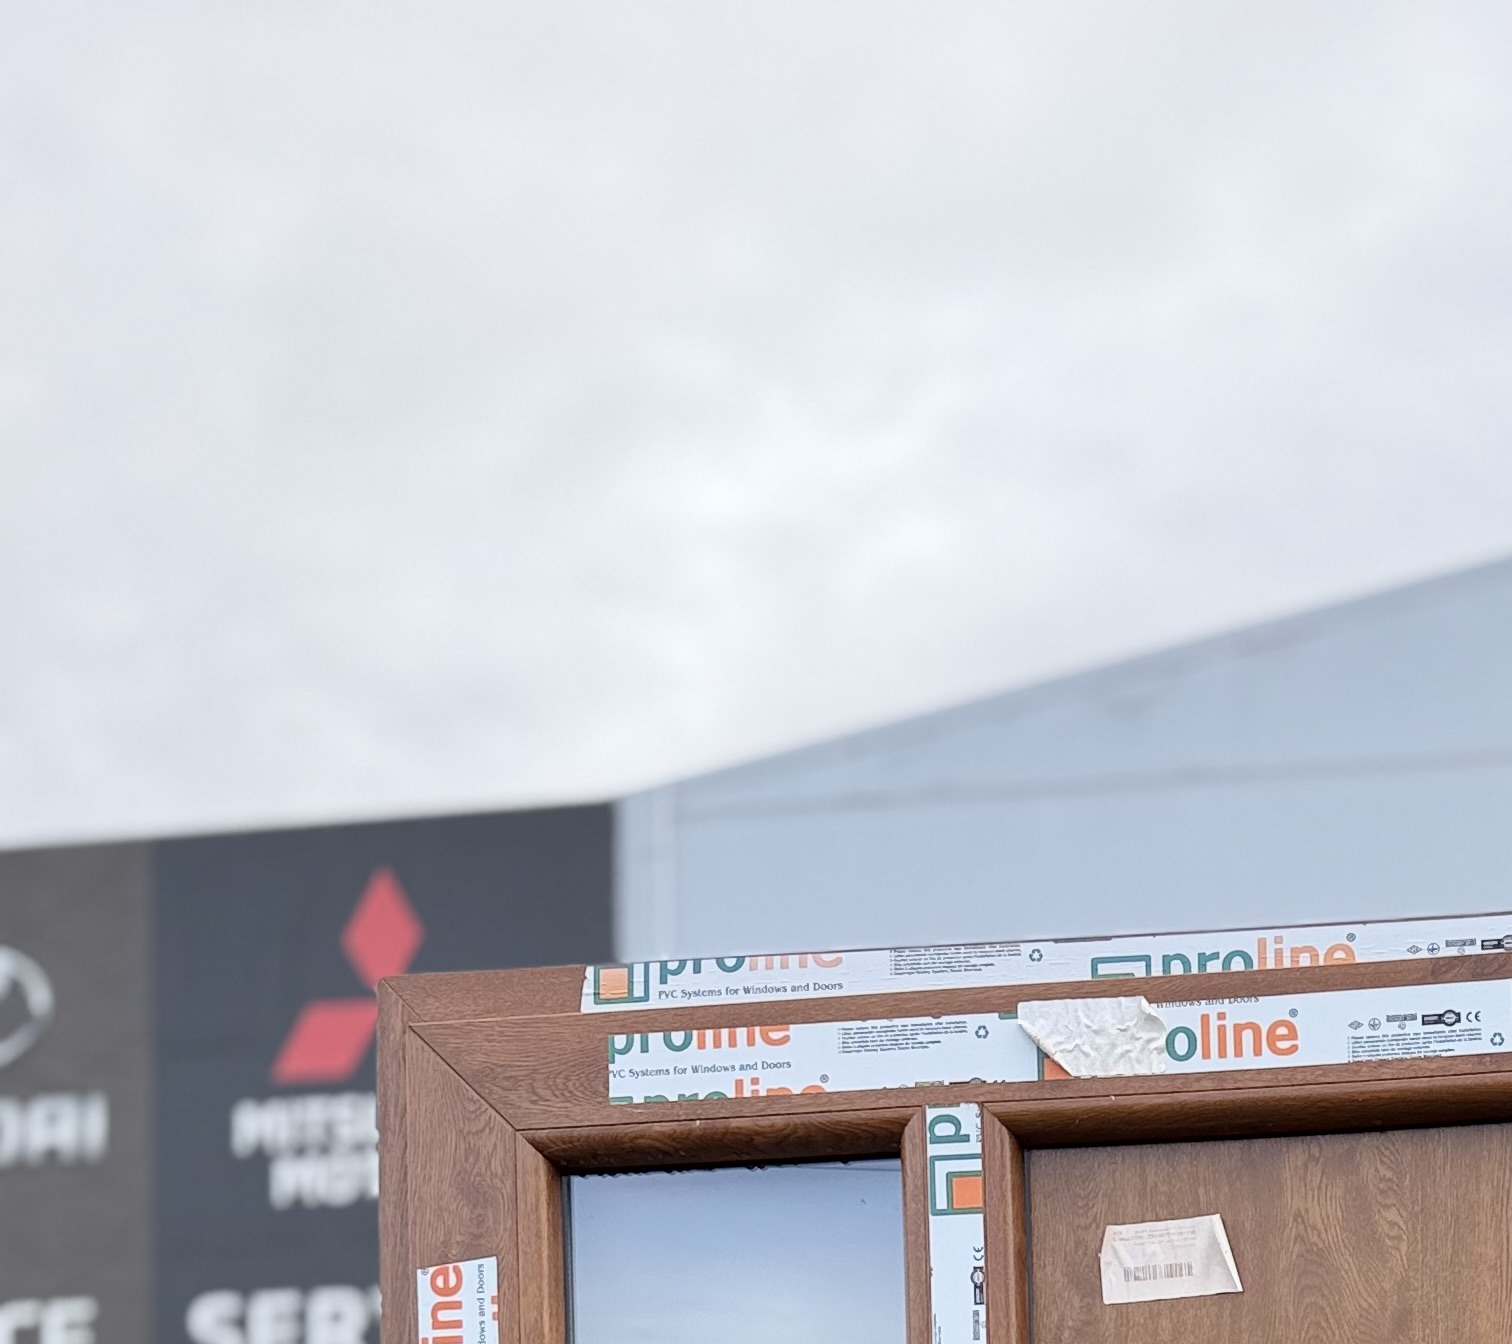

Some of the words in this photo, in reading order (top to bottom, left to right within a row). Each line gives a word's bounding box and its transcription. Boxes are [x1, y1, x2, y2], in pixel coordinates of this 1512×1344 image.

[657, 989, 678, 1000] PVC
[680, 988, 722, 1000] Systems
[725, 986, 740, 996] for
[742, 984, 788, 995] Windows
[790, 982, 810, 993] and
[812, 982, 844, 992] Doors
[1165, 1011, 1299, 1062] oline
[628, 1068, 670, 1079] Systems
[673, 1065, 688, 1075] for
[690, 1063, 736, 1074] Windows
[738, 1061, 758, 1071] and
[761, 1060, 792, 1070] Doors
[476, 1263, 485, 1294] Doors
[476, 1297, 486, 1317] and
